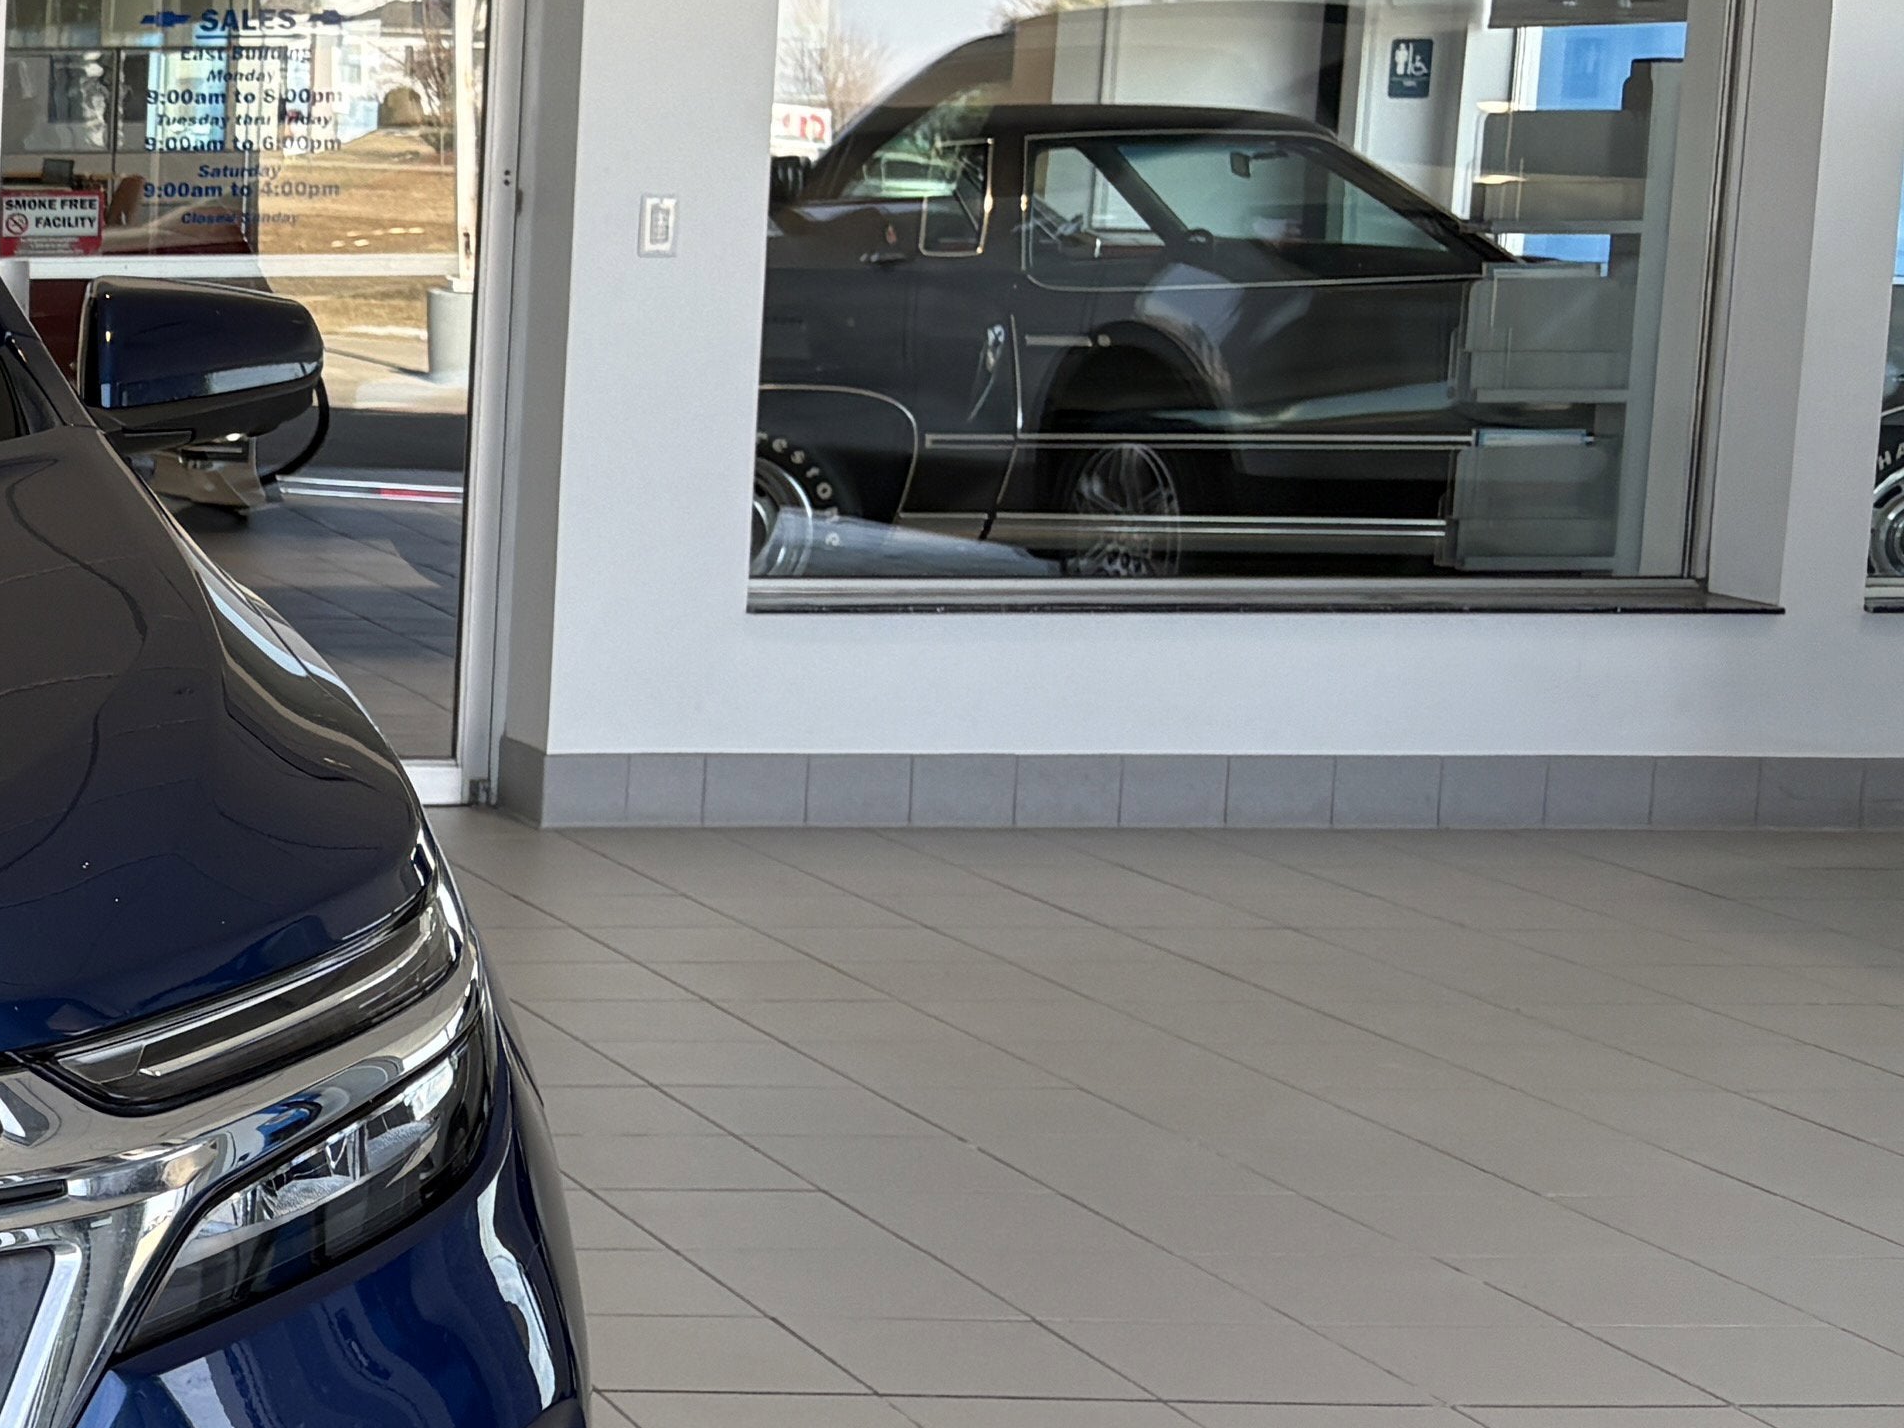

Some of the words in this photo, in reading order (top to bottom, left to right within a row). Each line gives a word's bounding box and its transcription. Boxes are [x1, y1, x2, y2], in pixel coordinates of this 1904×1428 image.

[200, 9, 297, 32] SALES
[180, 46, 225, 61] East
[206, 69, 274, 83] Monday
[147, 88, 227, 105] 9:00am
[235, 89, 256, 104] to
[263, 88, 343, 107] 800pm
[158, 113, 228, 130] Tuesday
[235, 113, 273, 127] thru
[278, 113, 333, 130] riday
[145, 136, 225, 152] 9:00am
[233, 137, 254, 152] to
[262, 136, 341, 154] 6:00pm
[198, 164, 282, 181] Saturday
[143, 182, 222, 198] 9:00am
[231, 182, 252, 198] to
[261, 181, 340, 199] 4:00pm
[5, 199, 57, 210] SMOKE
[61, 199, 97, 210] FREE
[35, 216, 97, 228] FACILITY
